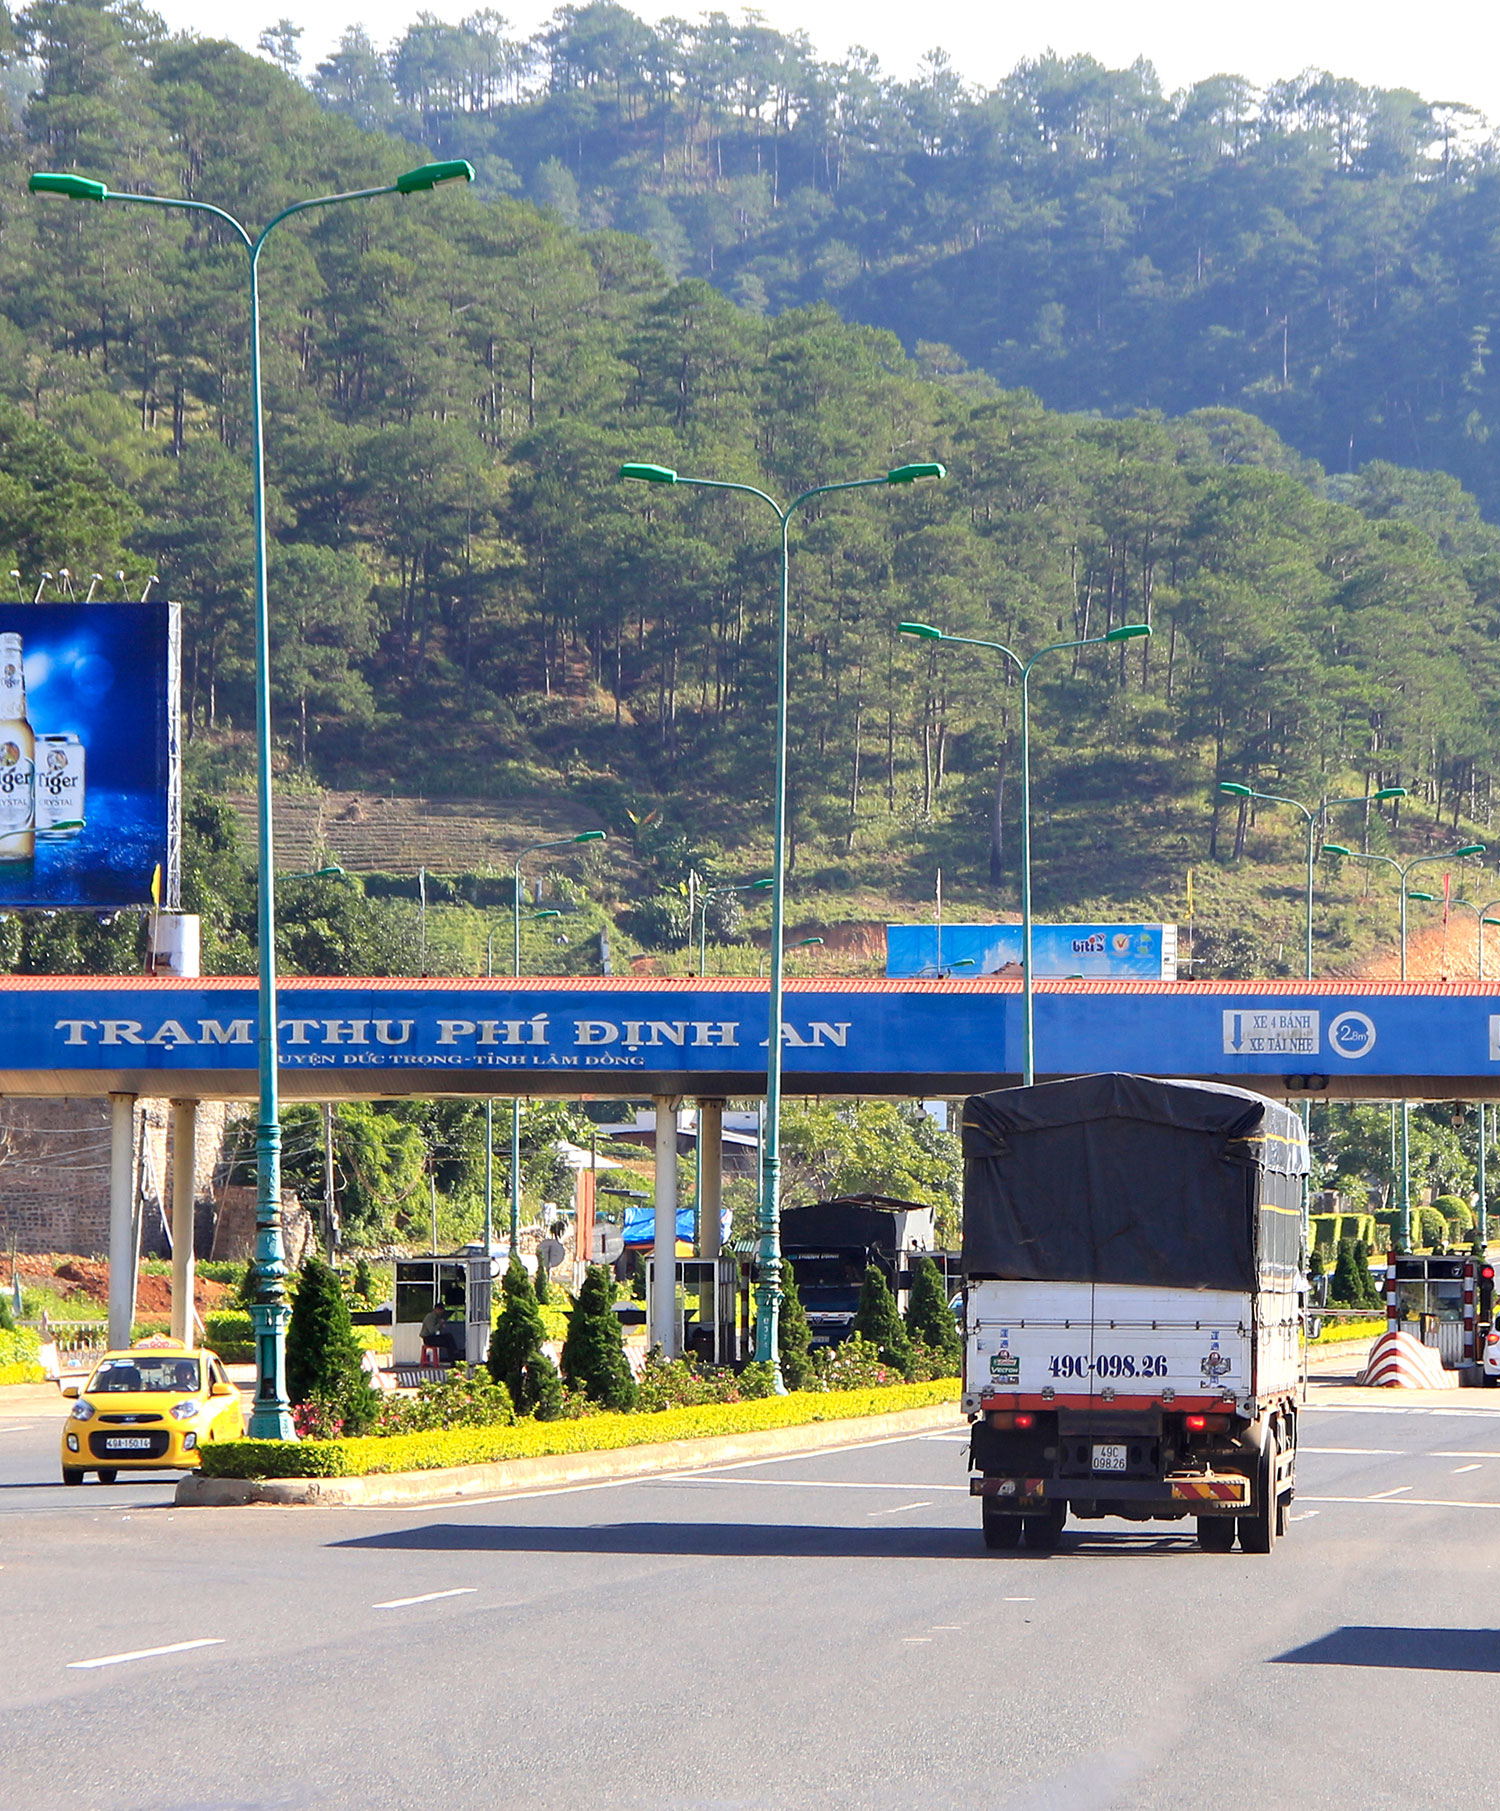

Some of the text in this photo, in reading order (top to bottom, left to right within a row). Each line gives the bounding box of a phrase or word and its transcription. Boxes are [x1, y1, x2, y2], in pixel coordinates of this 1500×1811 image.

[0, 767, 31, 793] iger
[38, 771, 78, 795] Tiger
[1252, 1011, 1311, 1029] XE 4 BÁNH
[54, 1012, 853, 1053] TRẠM THU PHÍ ĐỊNH AN
[1250, 1038, 1265, 1052] XE
[1048, 1354, 1168, 1378] 49C-098.26
[1101, 1447, 1119, 1457] 49C
[1093, 1458, 1125, 1469] 098.26
